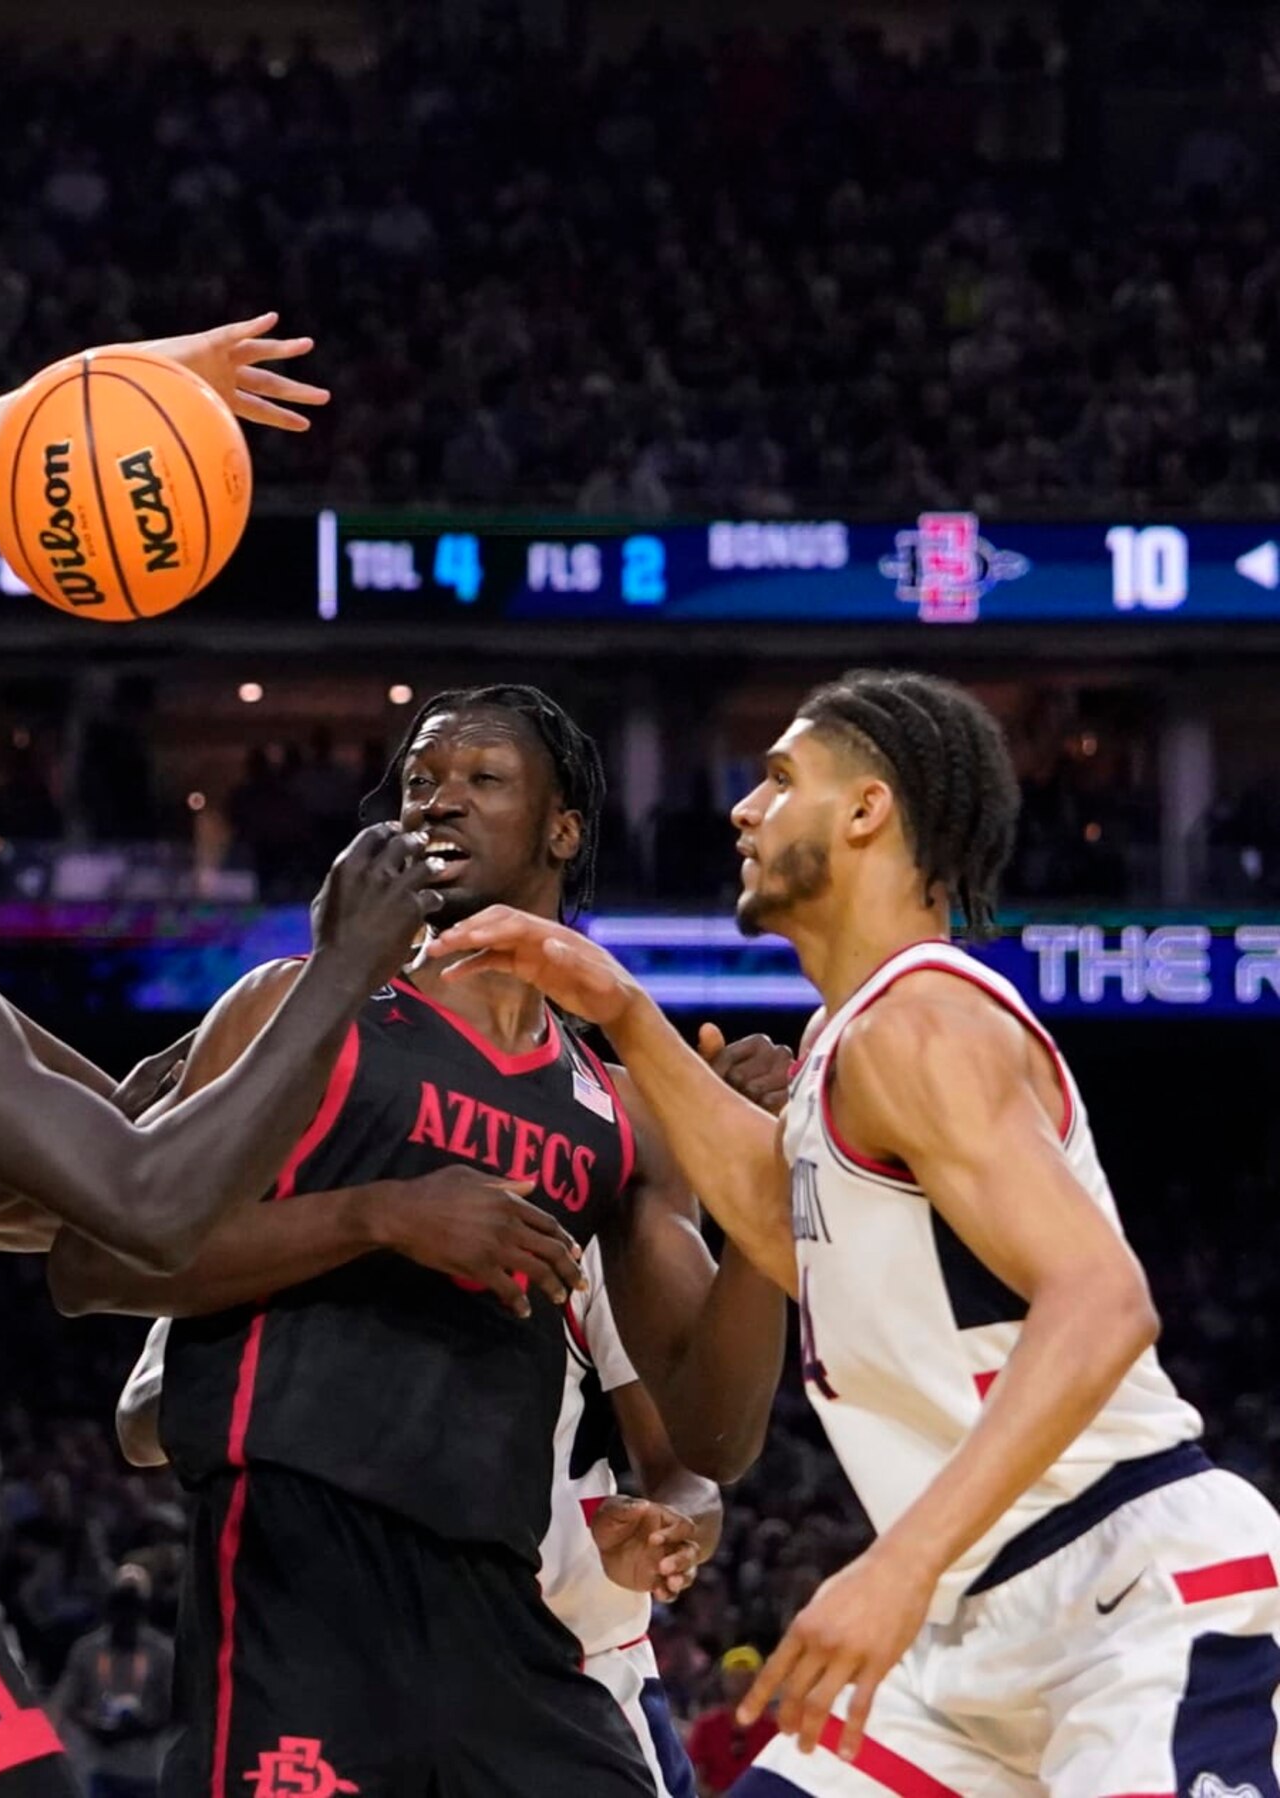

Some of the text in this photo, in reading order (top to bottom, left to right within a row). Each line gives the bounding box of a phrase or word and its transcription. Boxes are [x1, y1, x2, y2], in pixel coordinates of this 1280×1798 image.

[38, 439, 106, 606] Wilson
[117, 449, 181, 573] NCAA
[708, 520, 848, 569] BONUS
[433, 532, 481, 602] 4
[527, 535, 666, 605] FLS 2
[1106, 525, 1189, 610] 10
[1021, 925, 1212, 1003] THE
[407, 1081, 596, 1212] AZTECS
